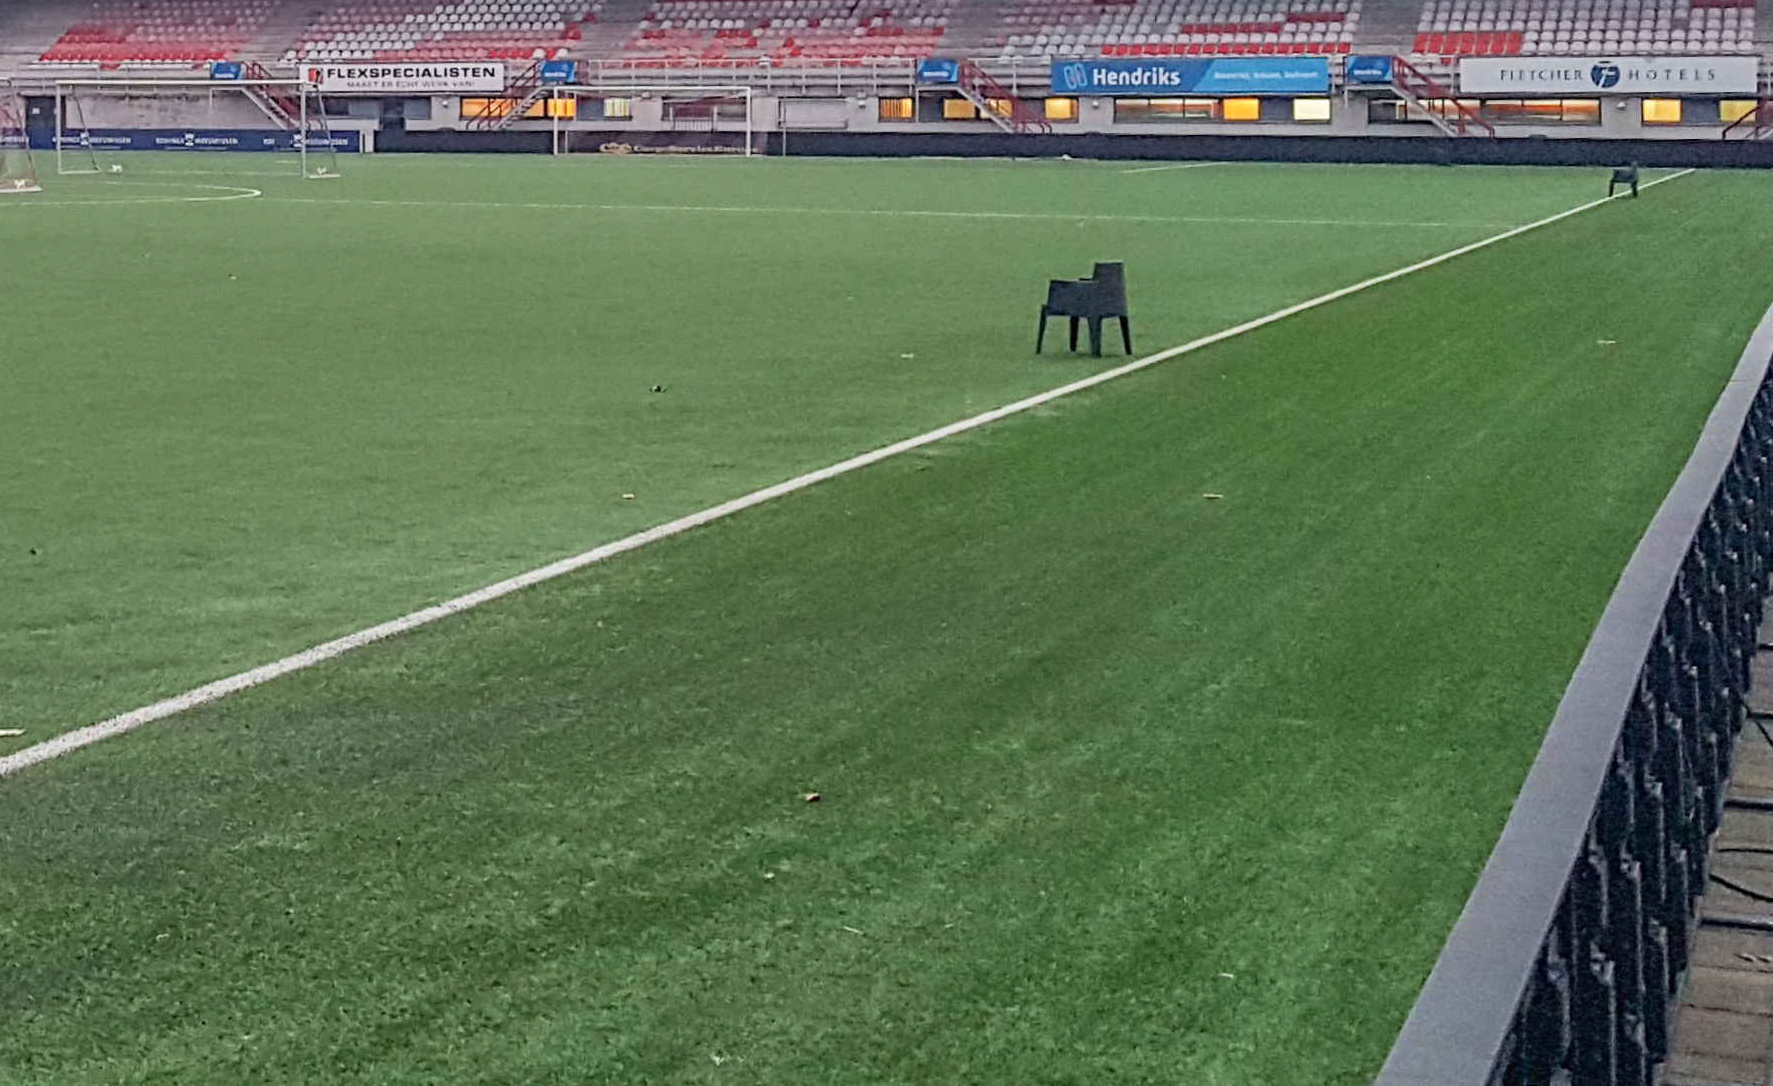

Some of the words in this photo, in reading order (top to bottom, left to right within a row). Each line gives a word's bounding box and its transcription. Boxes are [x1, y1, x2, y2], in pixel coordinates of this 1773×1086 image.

[327, 67, 496, 79] FLEXSPECIALISTEN
[1092, 67, 1181, 86] Hendriks
[1628, 69, 1716, 81] HOTELS
